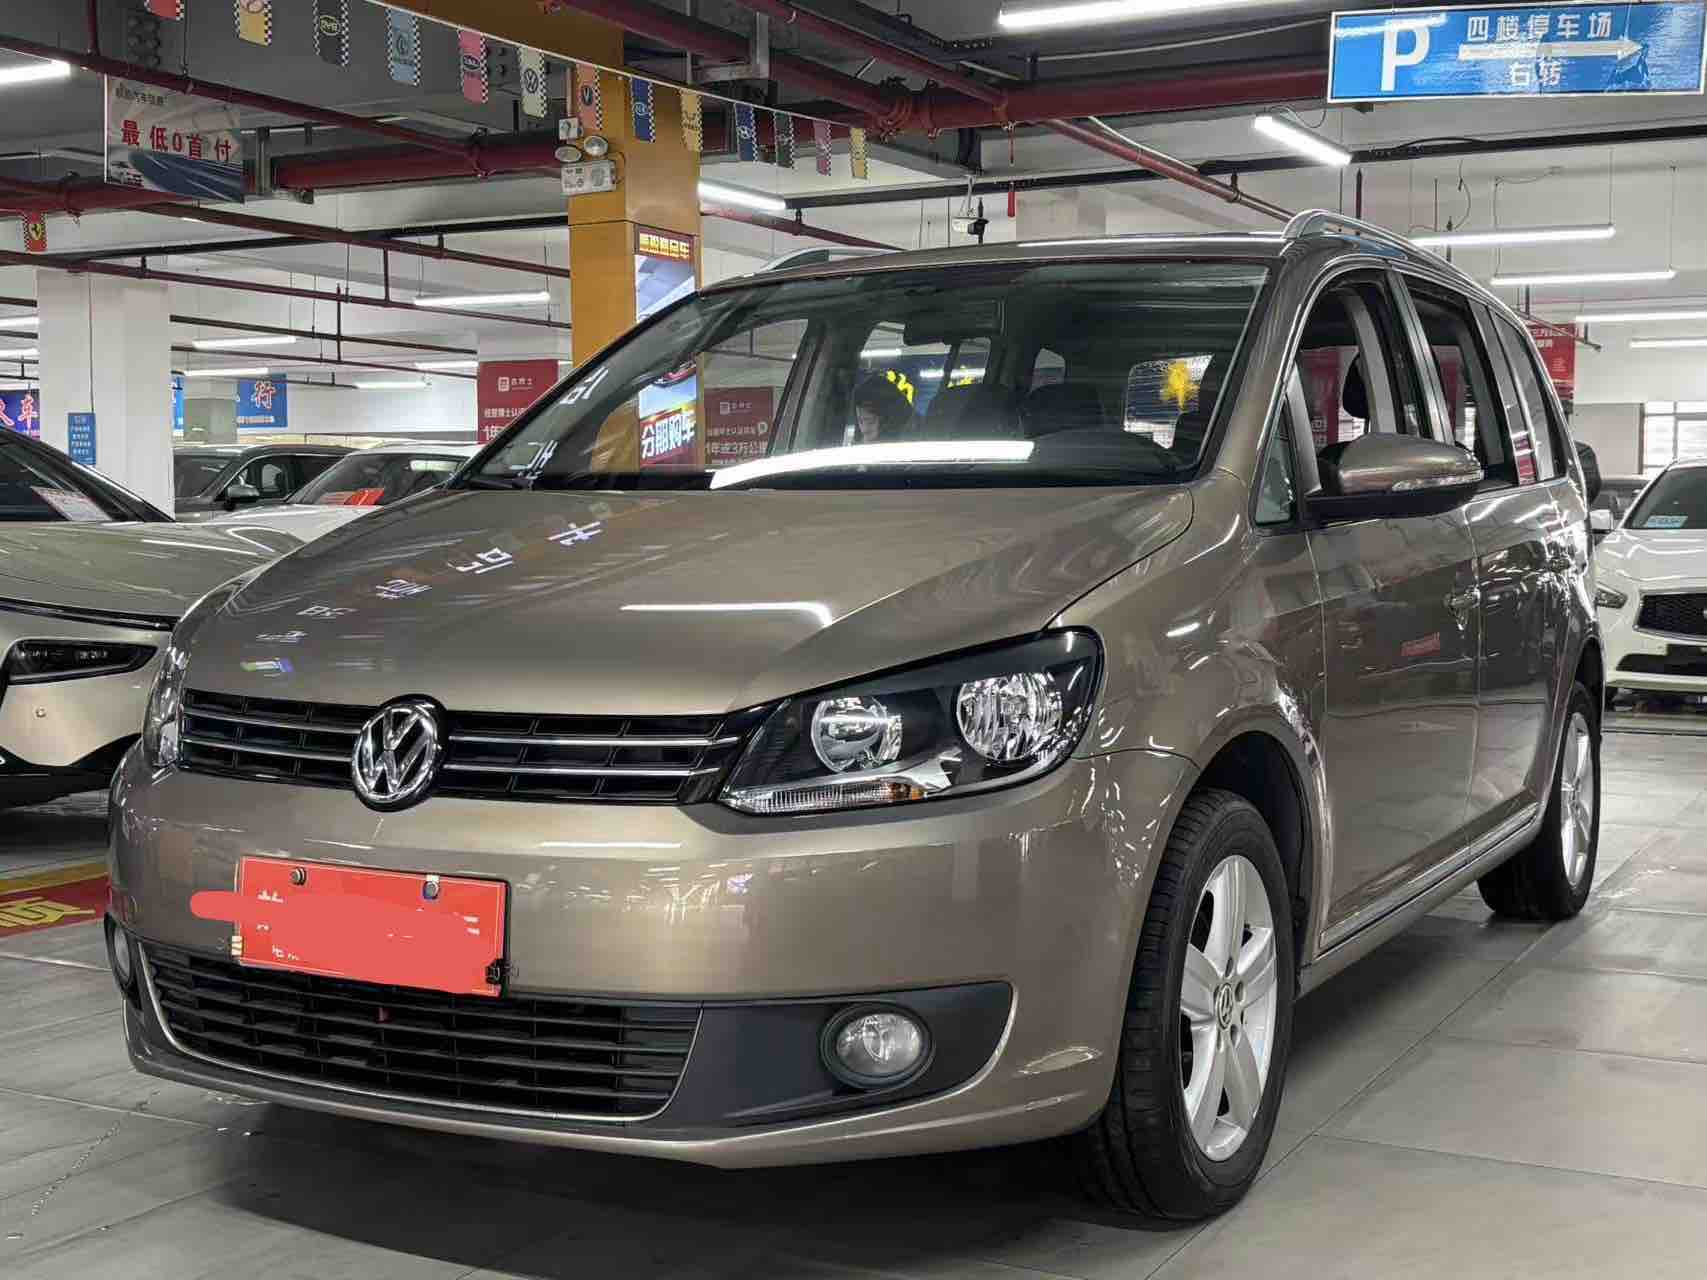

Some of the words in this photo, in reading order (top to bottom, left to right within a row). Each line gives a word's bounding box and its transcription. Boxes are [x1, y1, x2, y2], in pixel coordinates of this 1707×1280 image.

[1468, 12, 1612, 42] 四楼停车场
[1380, 20, 1430, 91] P
[1510, 60, 1562, 87] 右转
[120, 119, 232, 162] 最低0首付
[640, 412, 697, 460] 分期购车
